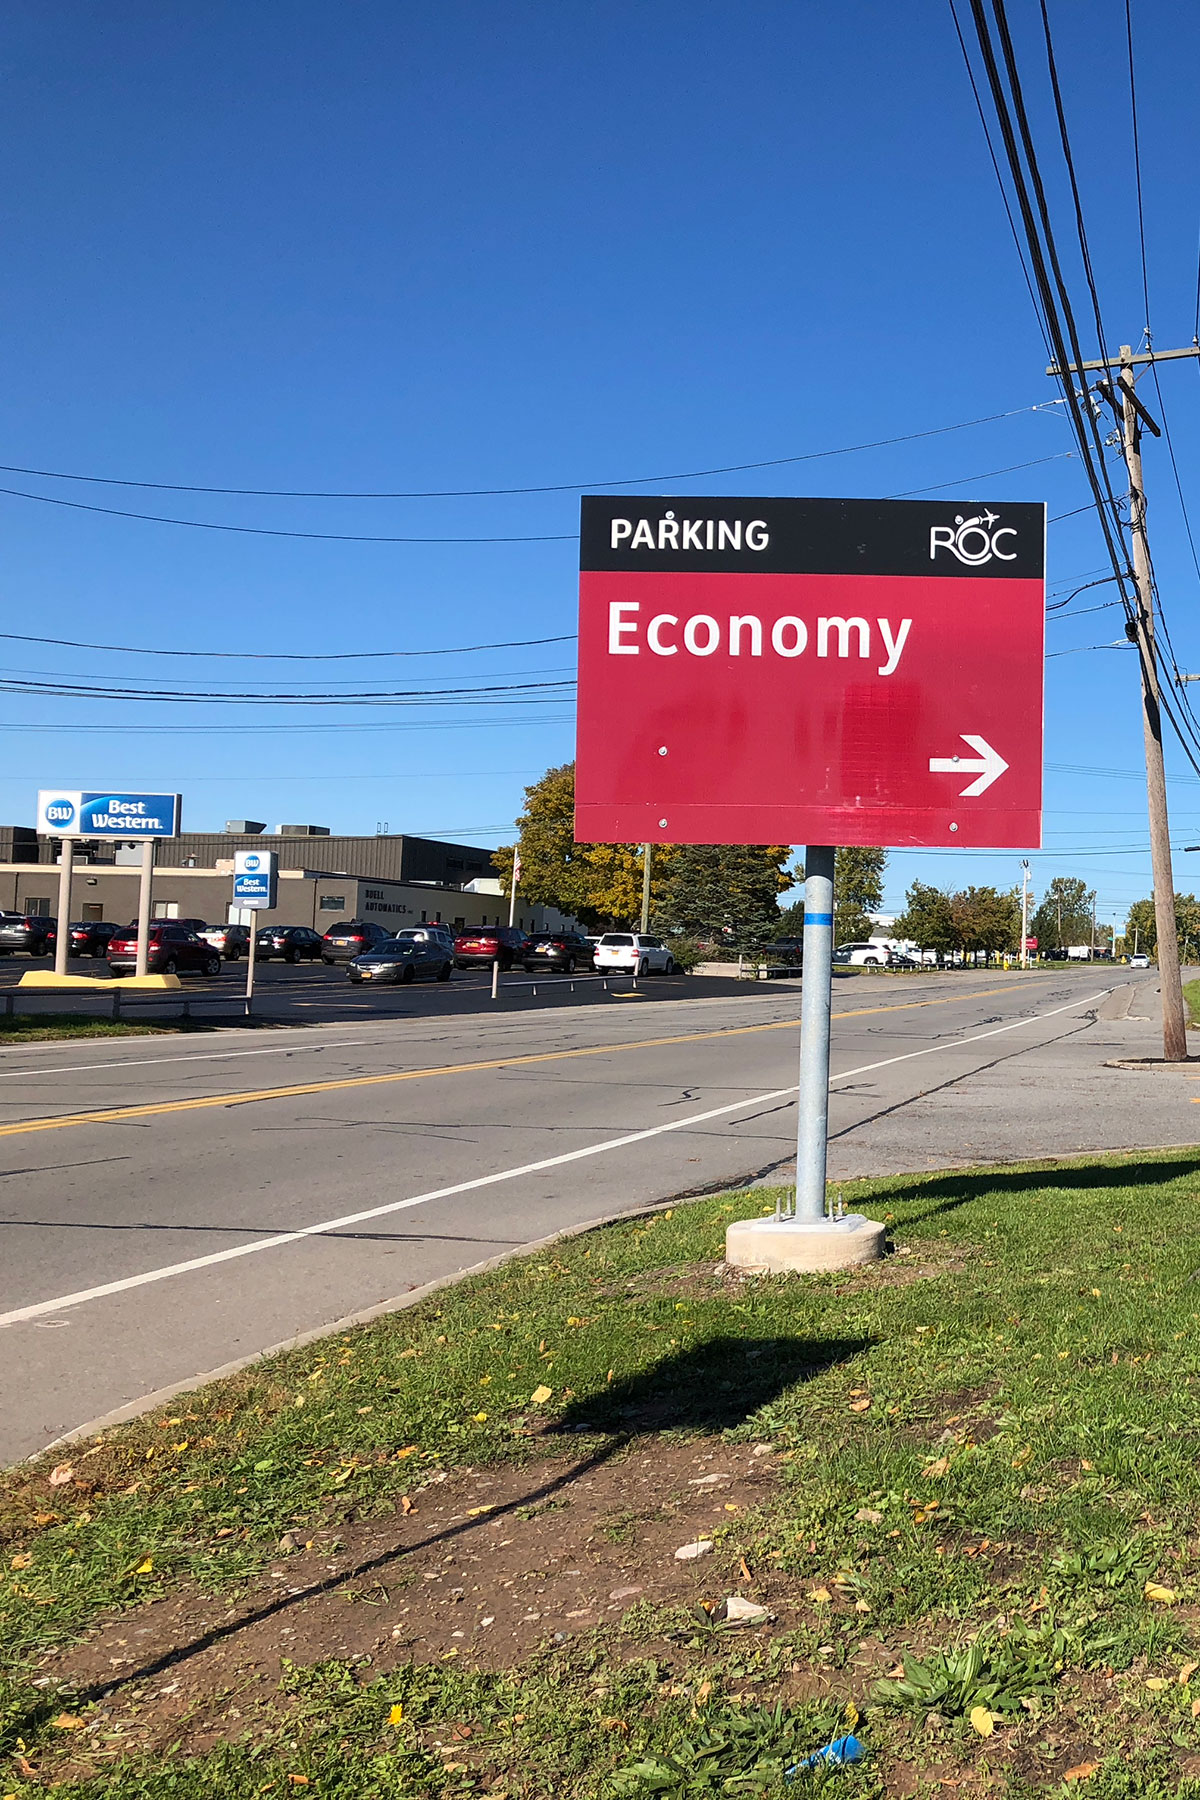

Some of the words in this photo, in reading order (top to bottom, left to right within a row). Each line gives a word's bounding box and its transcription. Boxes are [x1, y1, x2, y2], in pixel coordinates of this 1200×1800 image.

[610, 518, 770, 551] PARKING
[930, 518, 1018, 566] ROC
[607, 600, 913, 676] Economy
[47, 806, 73, 820] BW
[108, 799, 146, 814] Best
[245, 859, 259, 868] BW
[243, 878, 260, 886] Best
[365, 901, 406, 914] AUTOMATICS
